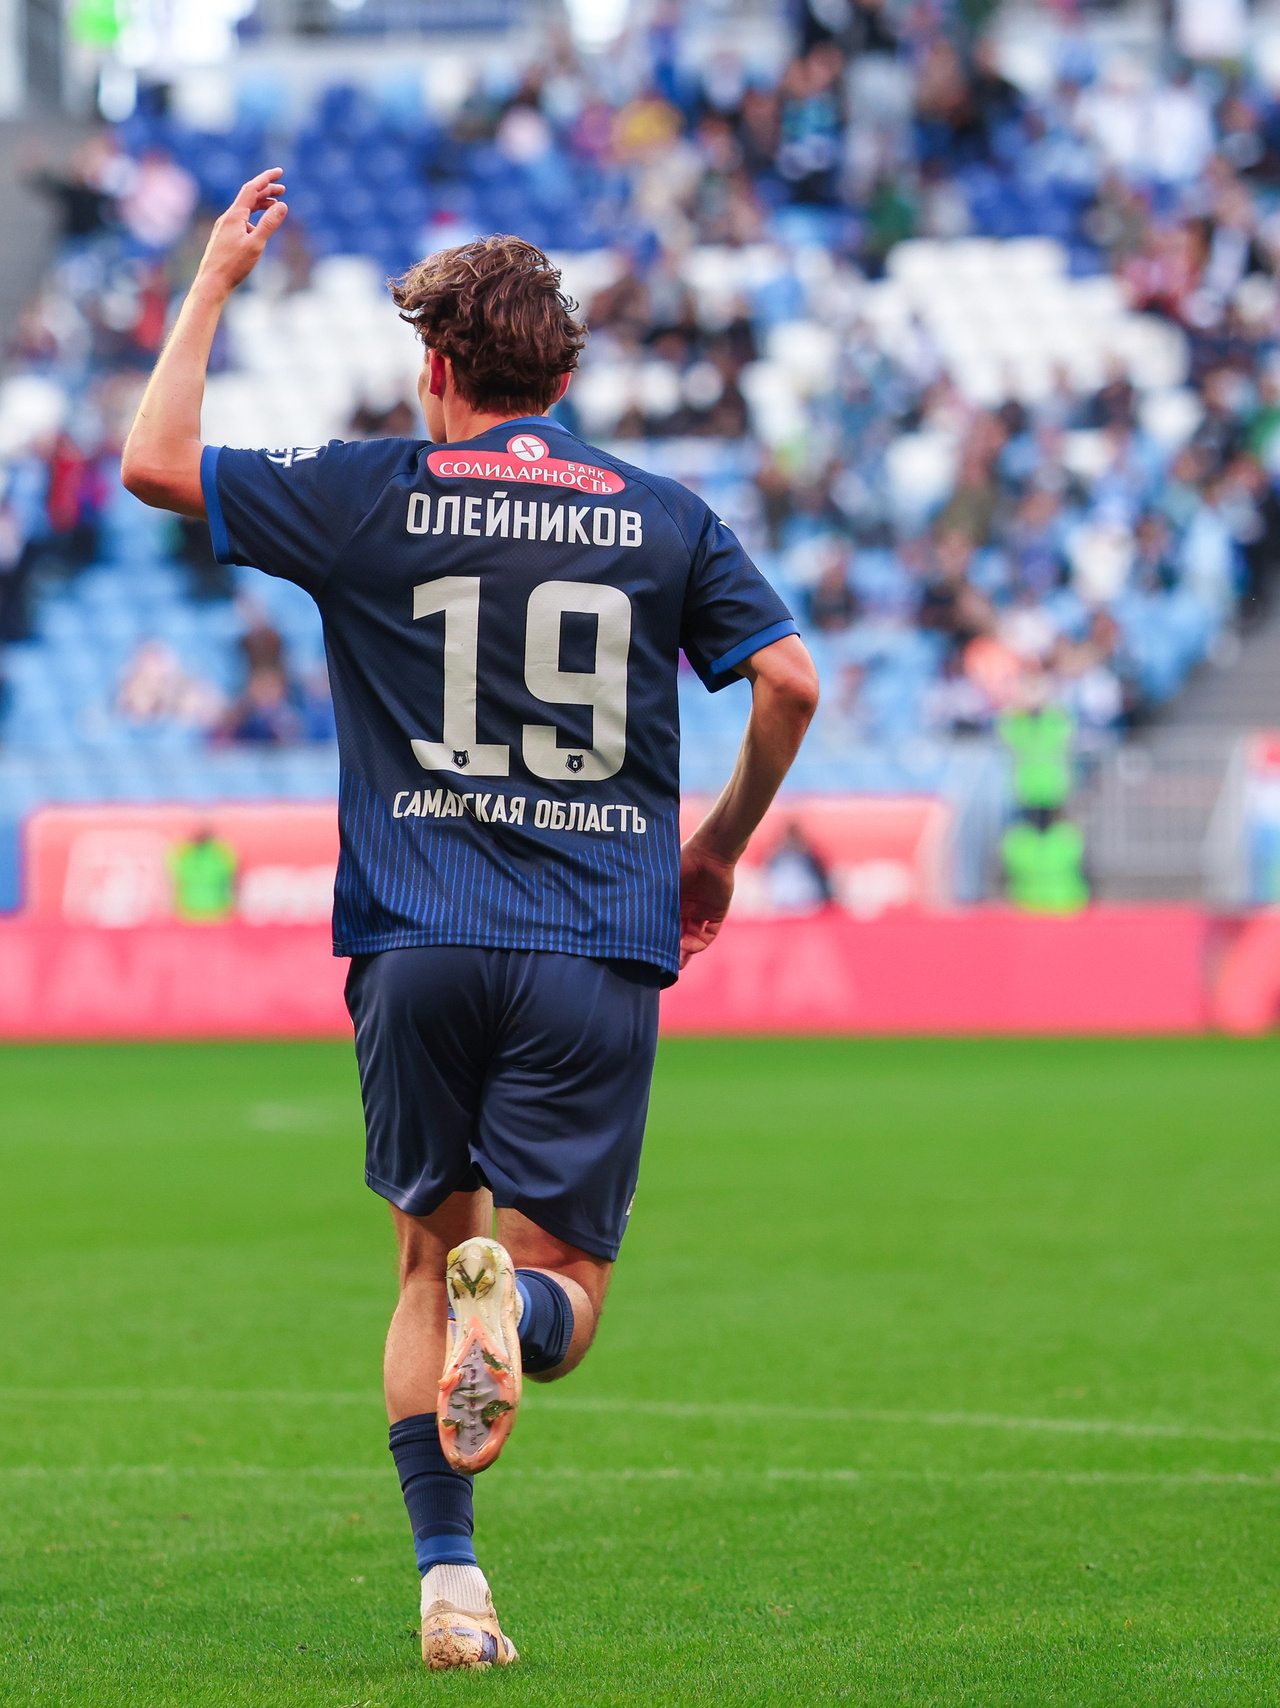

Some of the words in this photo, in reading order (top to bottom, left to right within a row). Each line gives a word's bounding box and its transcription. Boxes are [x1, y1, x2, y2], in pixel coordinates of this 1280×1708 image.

[439, 461, 614, 494] СОЛИДАРНОСТЬ
[567, 463, 605, 480] БАНК
[406, 491, 643, 548] ОЛЕЙНИКОВ
[411, 576, 632, 781] 19
[534, 799, 647, 834] ОБЛАСТЬ
